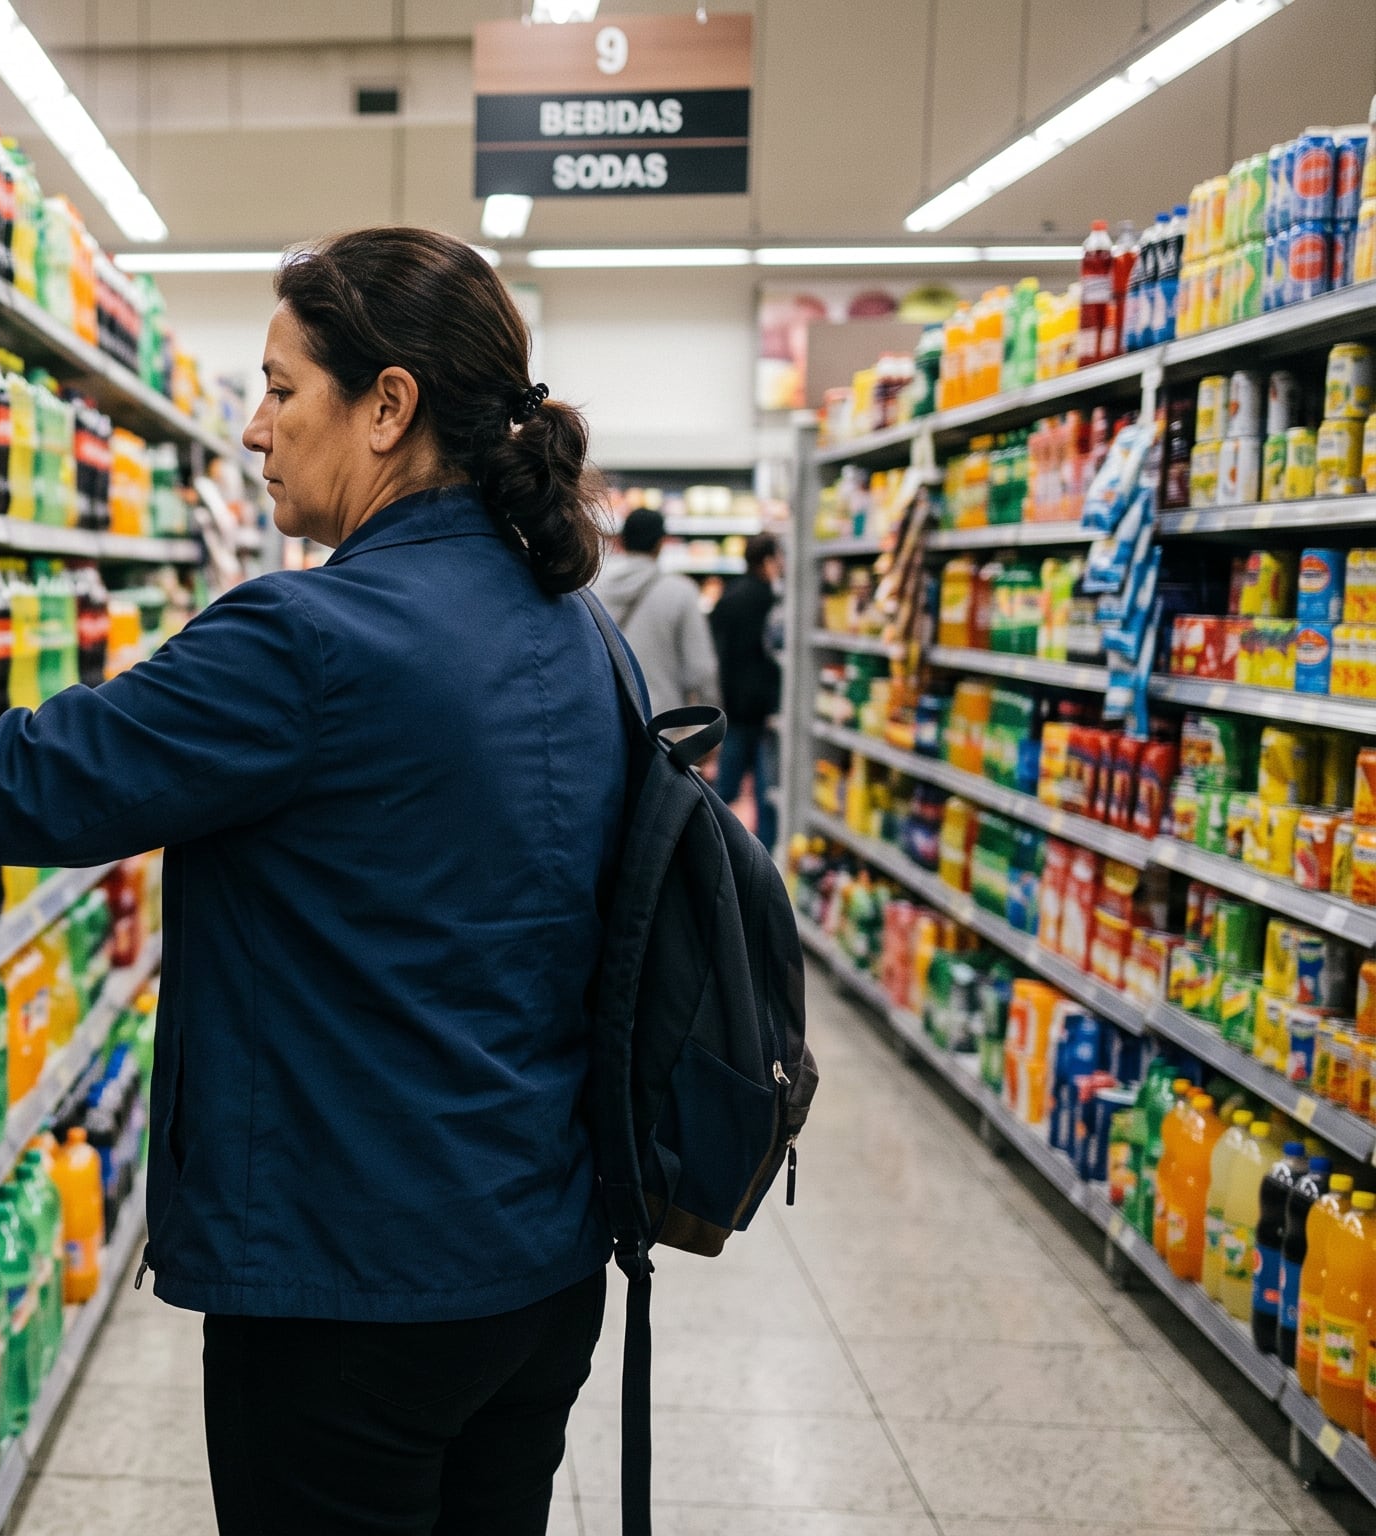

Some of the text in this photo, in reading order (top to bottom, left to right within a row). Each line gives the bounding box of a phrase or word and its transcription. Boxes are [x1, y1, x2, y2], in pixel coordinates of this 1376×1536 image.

[595, 26, 629, 75] 9
[539, 98, 684, 136] BEBIDAS
[552, 153, 668, 190] SODAS
